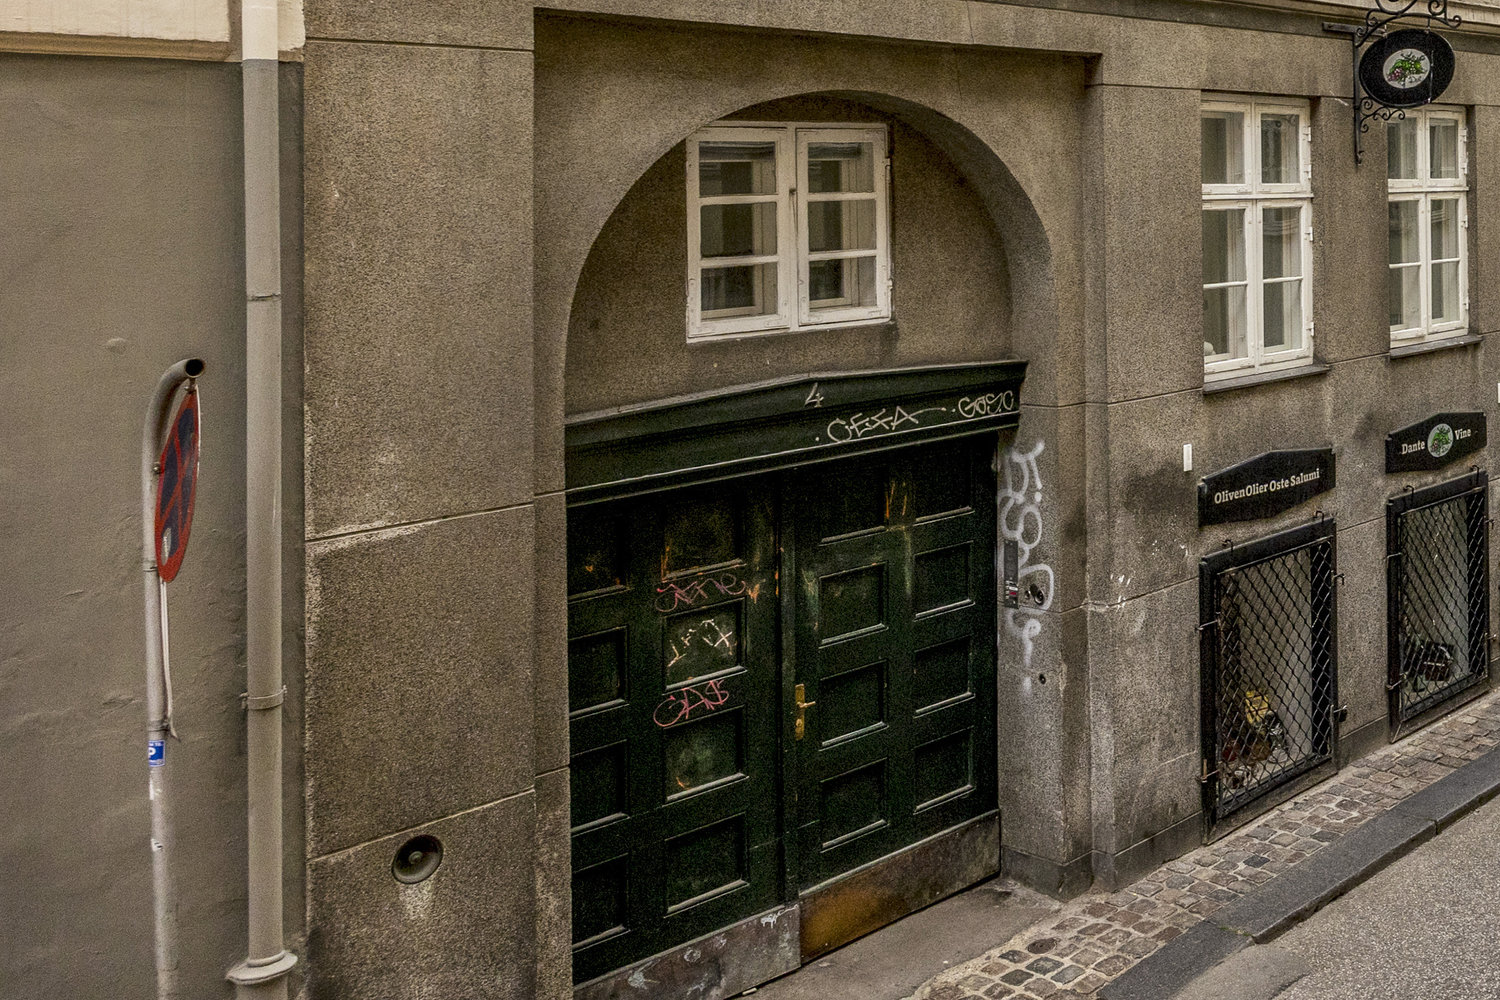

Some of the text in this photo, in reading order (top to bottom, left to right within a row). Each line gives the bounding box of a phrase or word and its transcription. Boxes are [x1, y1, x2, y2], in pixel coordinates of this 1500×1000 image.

[1401, 428, 1472, 455] Dante Vine
[1269, 478, 1290, 492] Oste
[1290, 467, 1320, 487] Salumi
